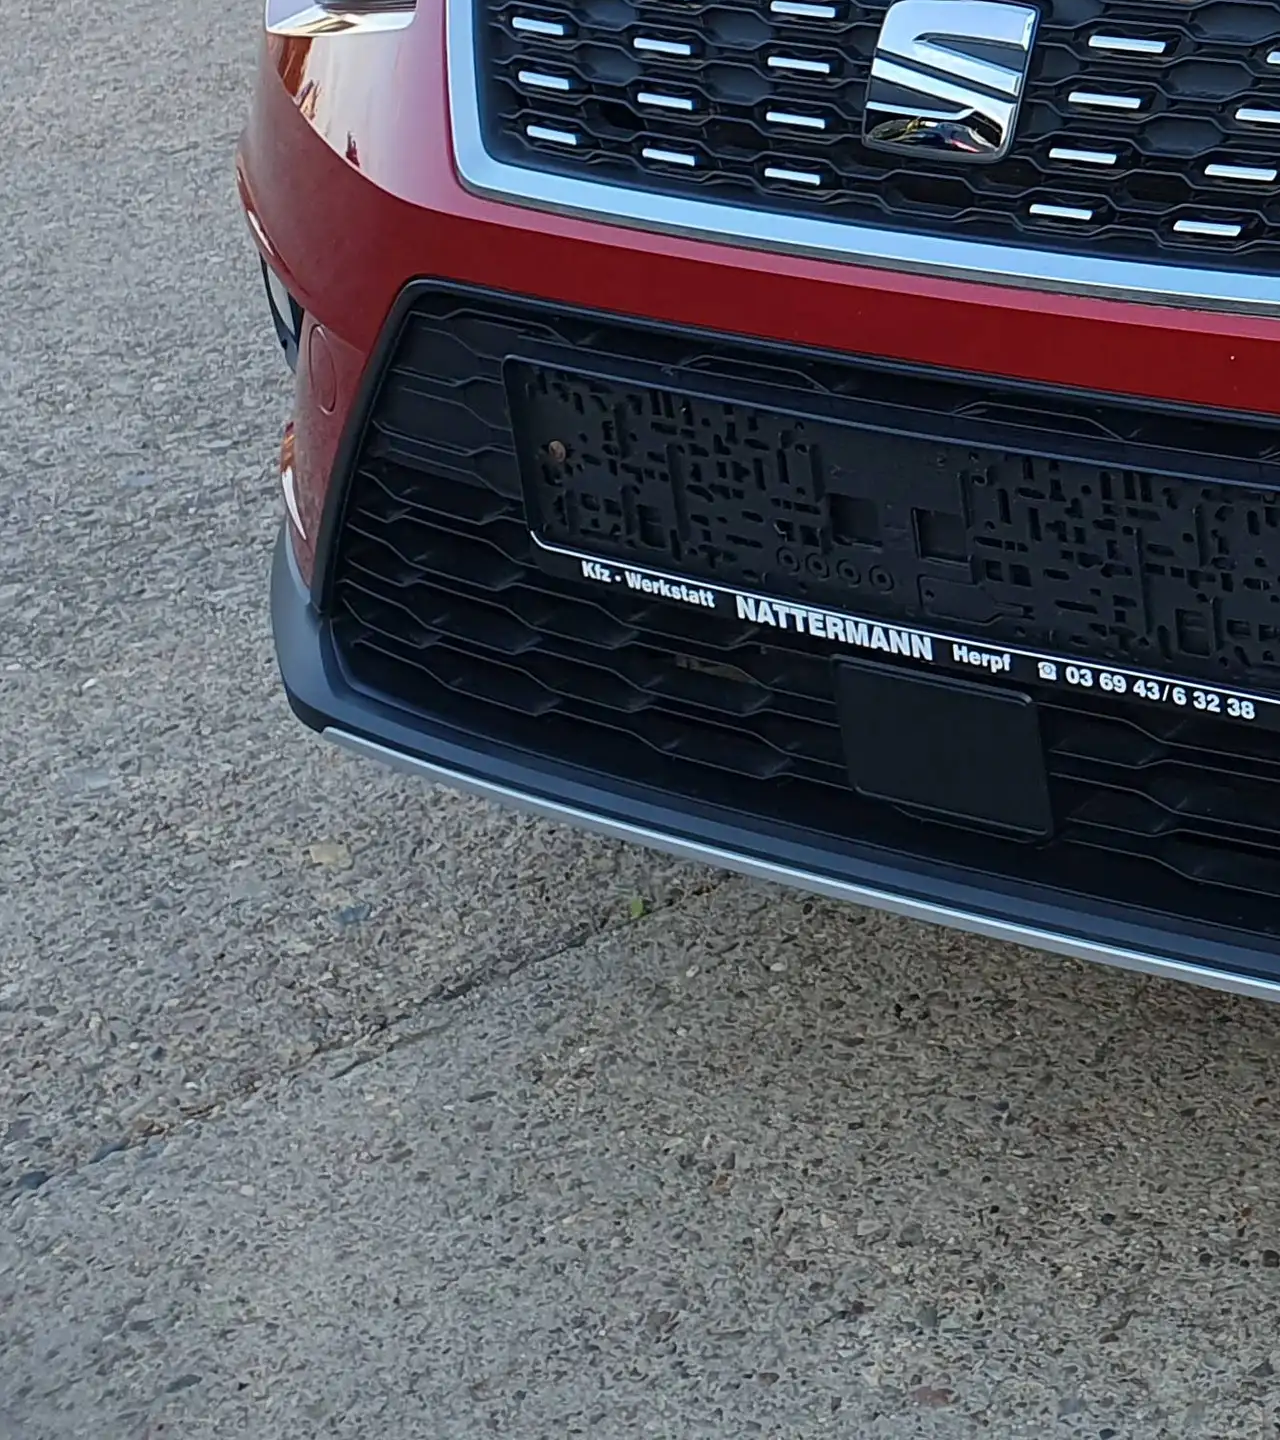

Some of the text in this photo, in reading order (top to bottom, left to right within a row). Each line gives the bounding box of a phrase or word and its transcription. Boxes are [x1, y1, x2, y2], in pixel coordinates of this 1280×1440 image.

[581, 560, 611, 583] Kfz
[625, 570, 715, 608] Werkstatt
[736, 595, 933, 661] NATTERMANN
[952, 643, 1011, 673] Herpf
[1065, 665, 1093, 687] 03
[1099, 671, 1127, 693] 69
[1193, 691, 1221, 713] 32
[1226, 697, 1256, 720] 38
